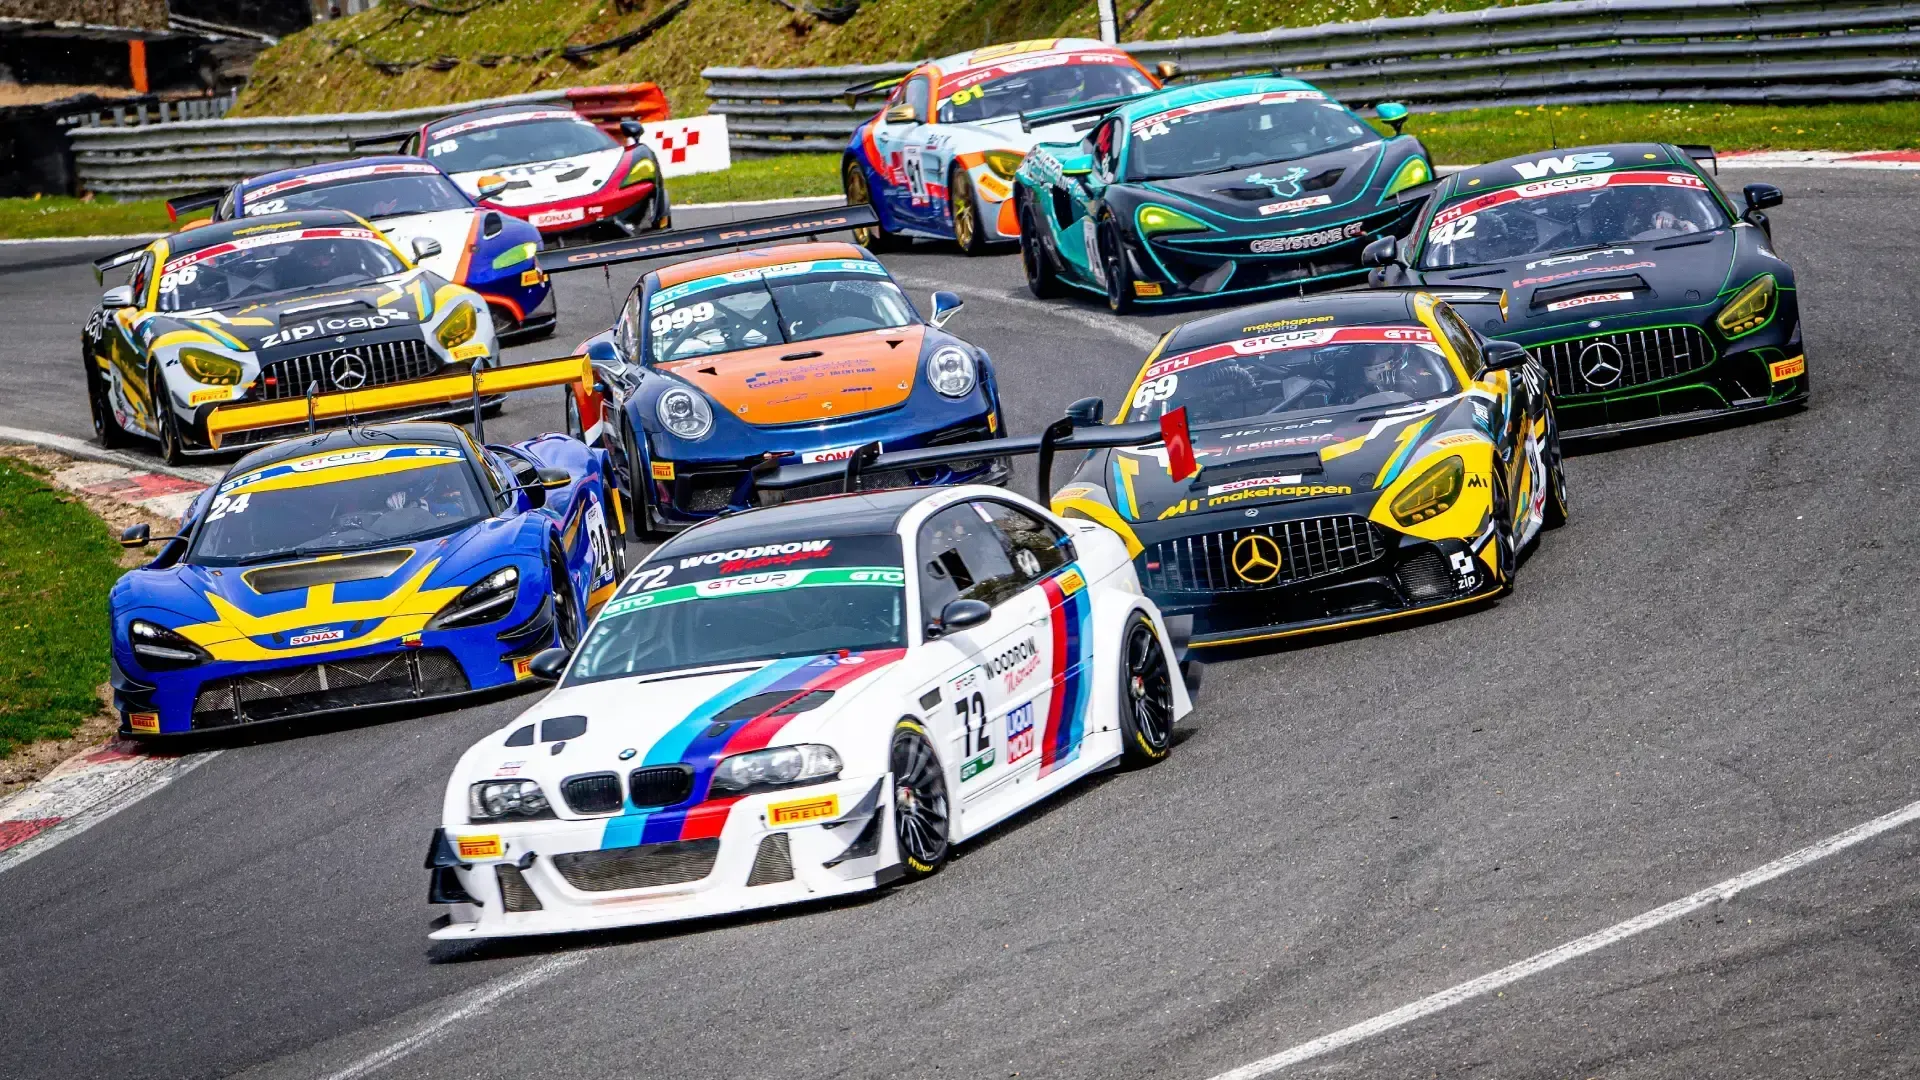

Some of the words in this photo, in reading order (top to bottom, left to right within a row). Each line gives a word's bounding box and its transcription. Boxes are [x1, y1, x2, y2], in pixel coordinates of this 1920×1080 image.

[951, 85, 984, 105] 91
[1133, 122, 1170, 142] 14
[428, 140, 459, 157] 78
[1511, 152, 1614, 179] WS
[1526, 176, 1593, 191] GTCUP
[1268, 198, 1319, 212] SONAX
[539, 213, 573, 224] SONAX
[1250, 228, 1342, 253] GREYSTONE
[1343, 222, 1364, 238] GT
[1431, 215, 1478, 245] 42
[164, 255, 197, 271] GTH
[732, 265, 798, 279] GTCUP
[841, 262, 881, 272] GTC
[159, 265, 199, 293] 96
[1557, 293, 1621, 309] SONAX
[651, 302, 714, 336] 999
[1242, 315, 1334, 333] makehappen
[1243, 331, 1317, 348] GTCUP
[1384, 329, 1432, 341] GTH
[1145, 356, 1190, 378] GTH
[1132, 374, 1178, 409] 69
[300, 451, 371, 467] GTCUP
[415, 447, 462, 457] GT3
[815, 449, 855, 463] SONA
[220, 473, 262, 492] GT3
[1222, 478, 1281, 491] SONAX
[1208, 484, 1351, 507] makehappen
[205, 493, 252, 524] 24
[679, 539, 832, 569] WOODROW
[719, 545, 834, 574] Motorsport
[626, 565, 676, 595] 72
[706, 573, 787, 590] GTCUP
[849, 571, 905, 582] GTO
[1458, 575, 1476, 590] zip
[604, 596, 655, 615] GTO
[292, 632, 339, 645] SONAX
[983, 635, 1037, 680] WOODROW
[955, 691, 990, 758] 72
[1008, 703, 1034, 738] LIQUI
[1008, 731, 1034, 764] MOLY
[773, 800, 833, 822] PIRELLI
[459, 840, 497, 856] PIRELLI
